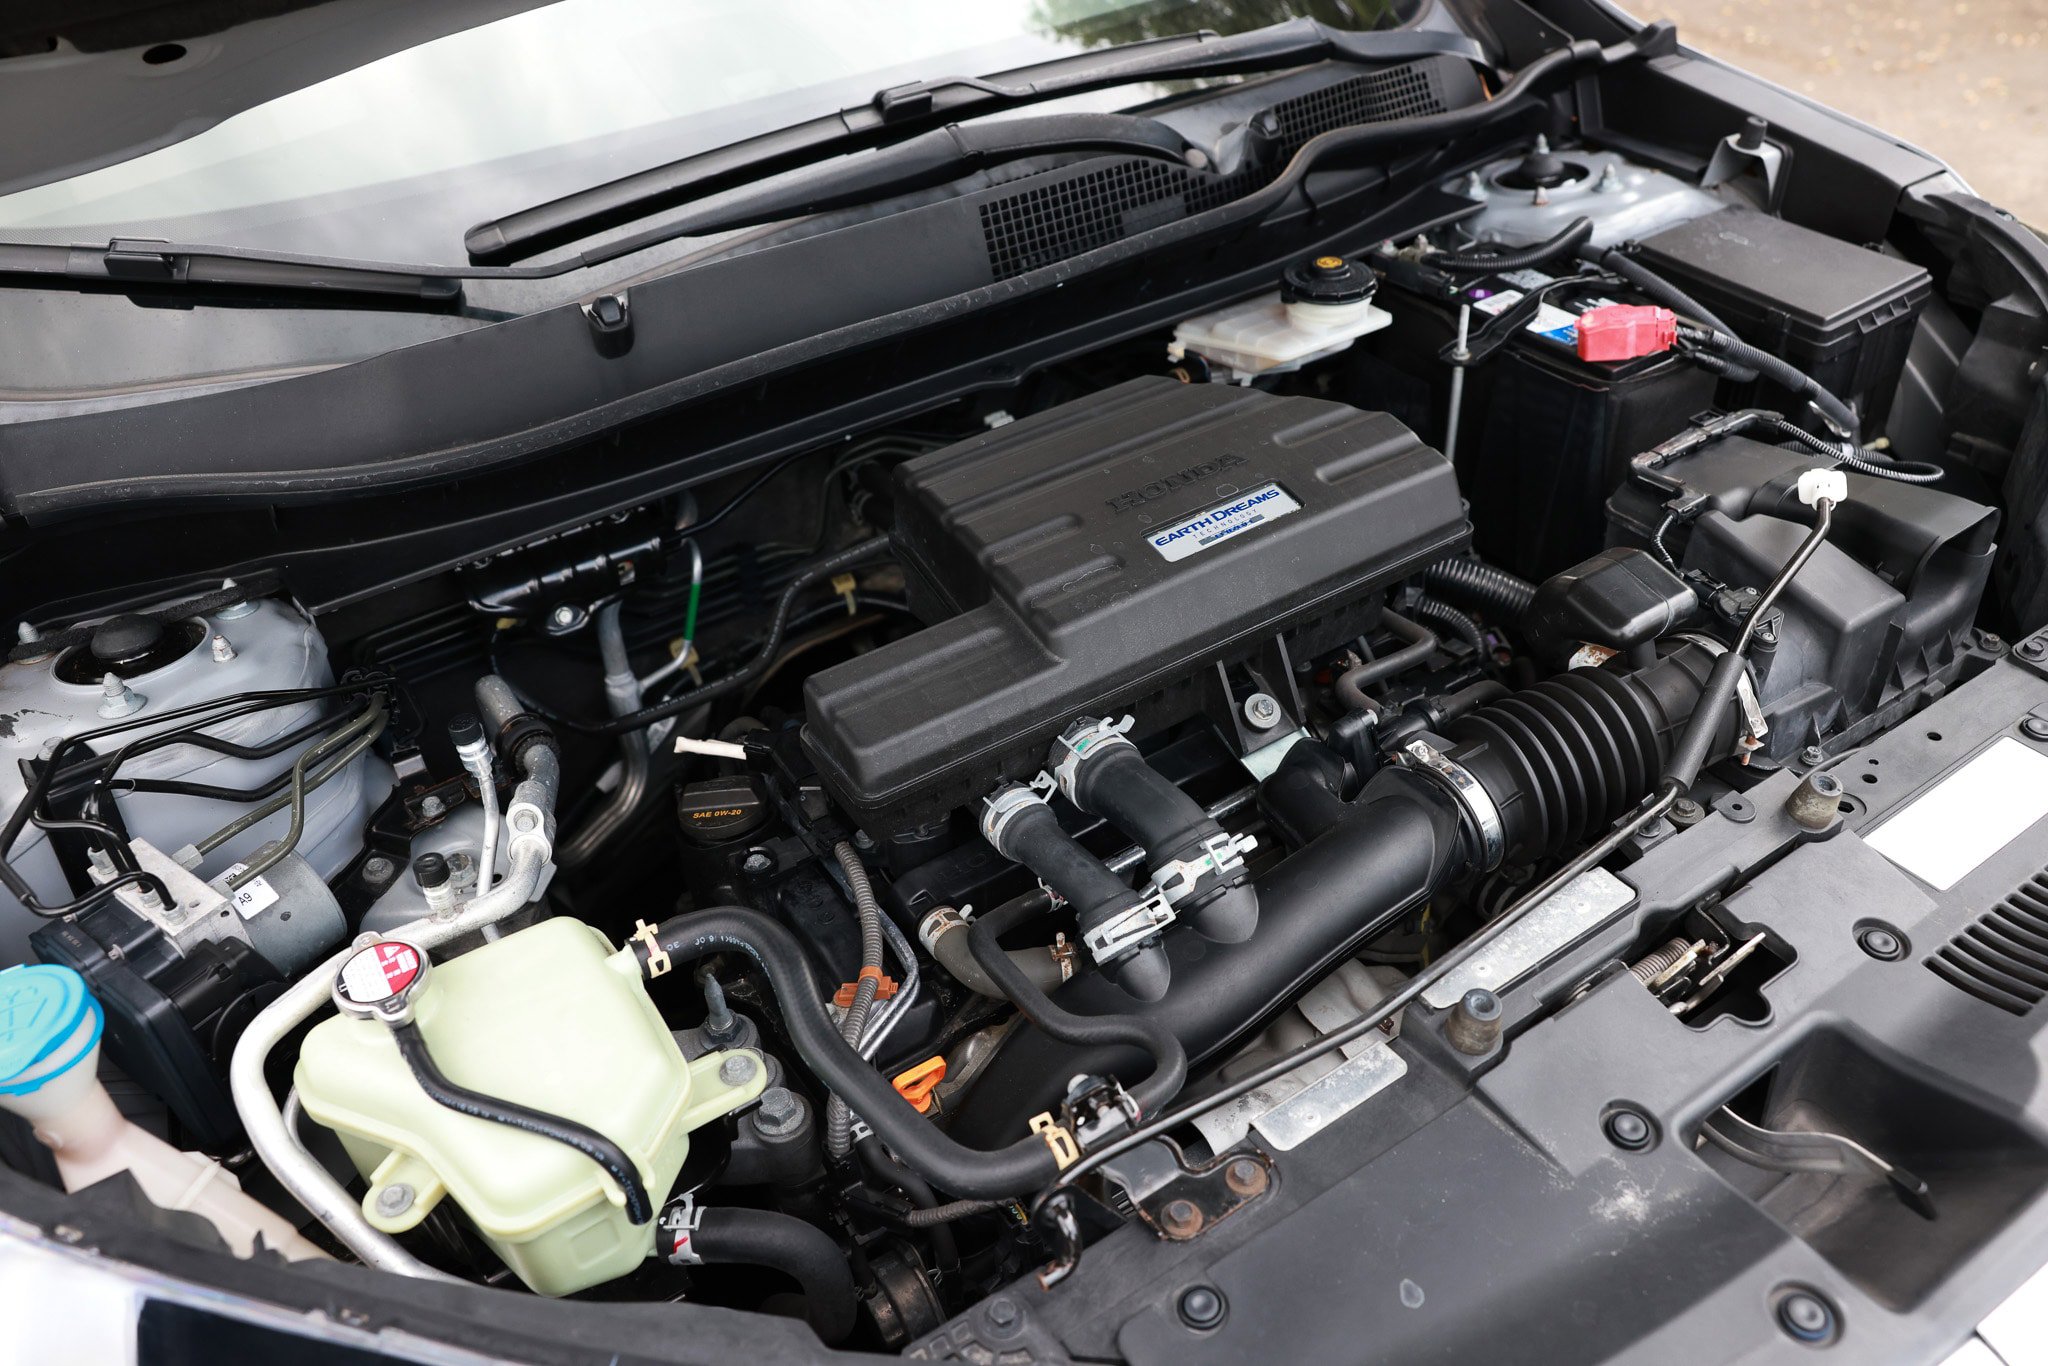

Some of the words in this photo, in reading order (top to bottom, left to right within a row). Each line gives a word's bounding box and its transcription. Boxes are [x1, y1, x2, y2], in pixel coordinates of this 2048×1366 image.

[1106, 453, 1249, 514] HONDA
[1155, 517, 1210, 547] EARTH
[1210, 488, 1280, 522] DREAMS
[1192, 508, 1257, 539] TECHNOLOGY
[692, 811, 712, 819] SAE
[714, 809, 742, 817] 0W-20
[238, 892, 253, 906] A9
